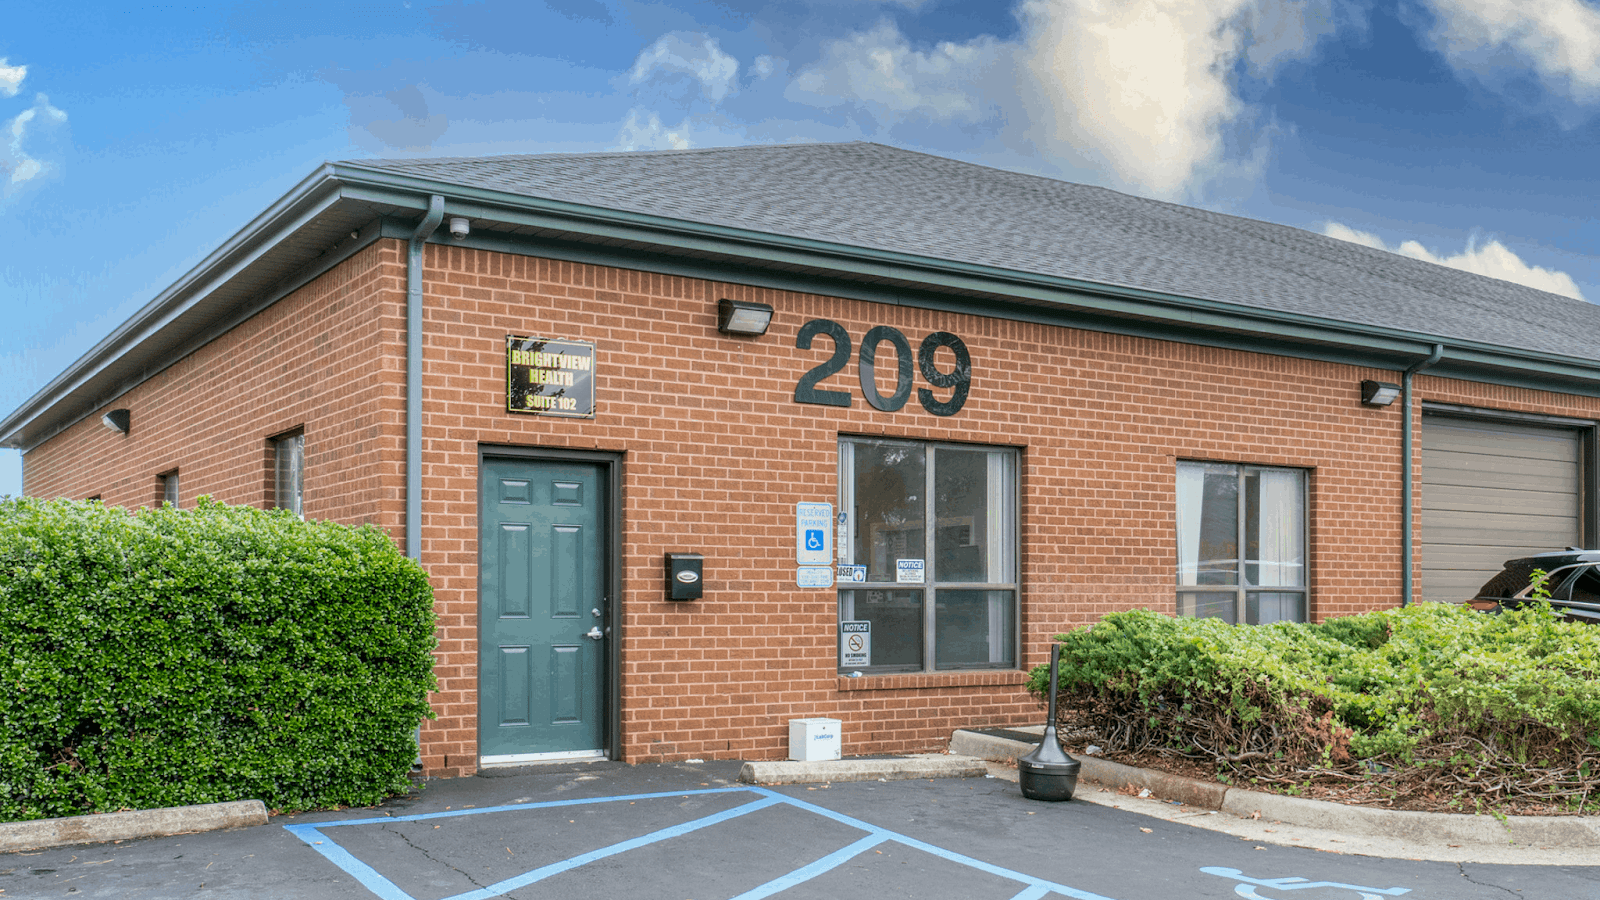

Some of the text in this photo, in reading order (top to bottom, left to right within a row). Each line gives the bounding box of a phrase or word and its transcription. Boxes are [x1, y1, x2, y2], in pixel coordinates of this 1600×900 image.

[511, 350, 591, 371] BRIGHTVIEW
[794, 318, 972, 417] 209
[529, 368, 574, 386] HEALTH
[525, 394, 577, 411] SUITE 102
[800, 508, 830, 518] RESERVED
[801, 518, 829, 528] PARKING
[837, 566, 853, 577] LOSED
